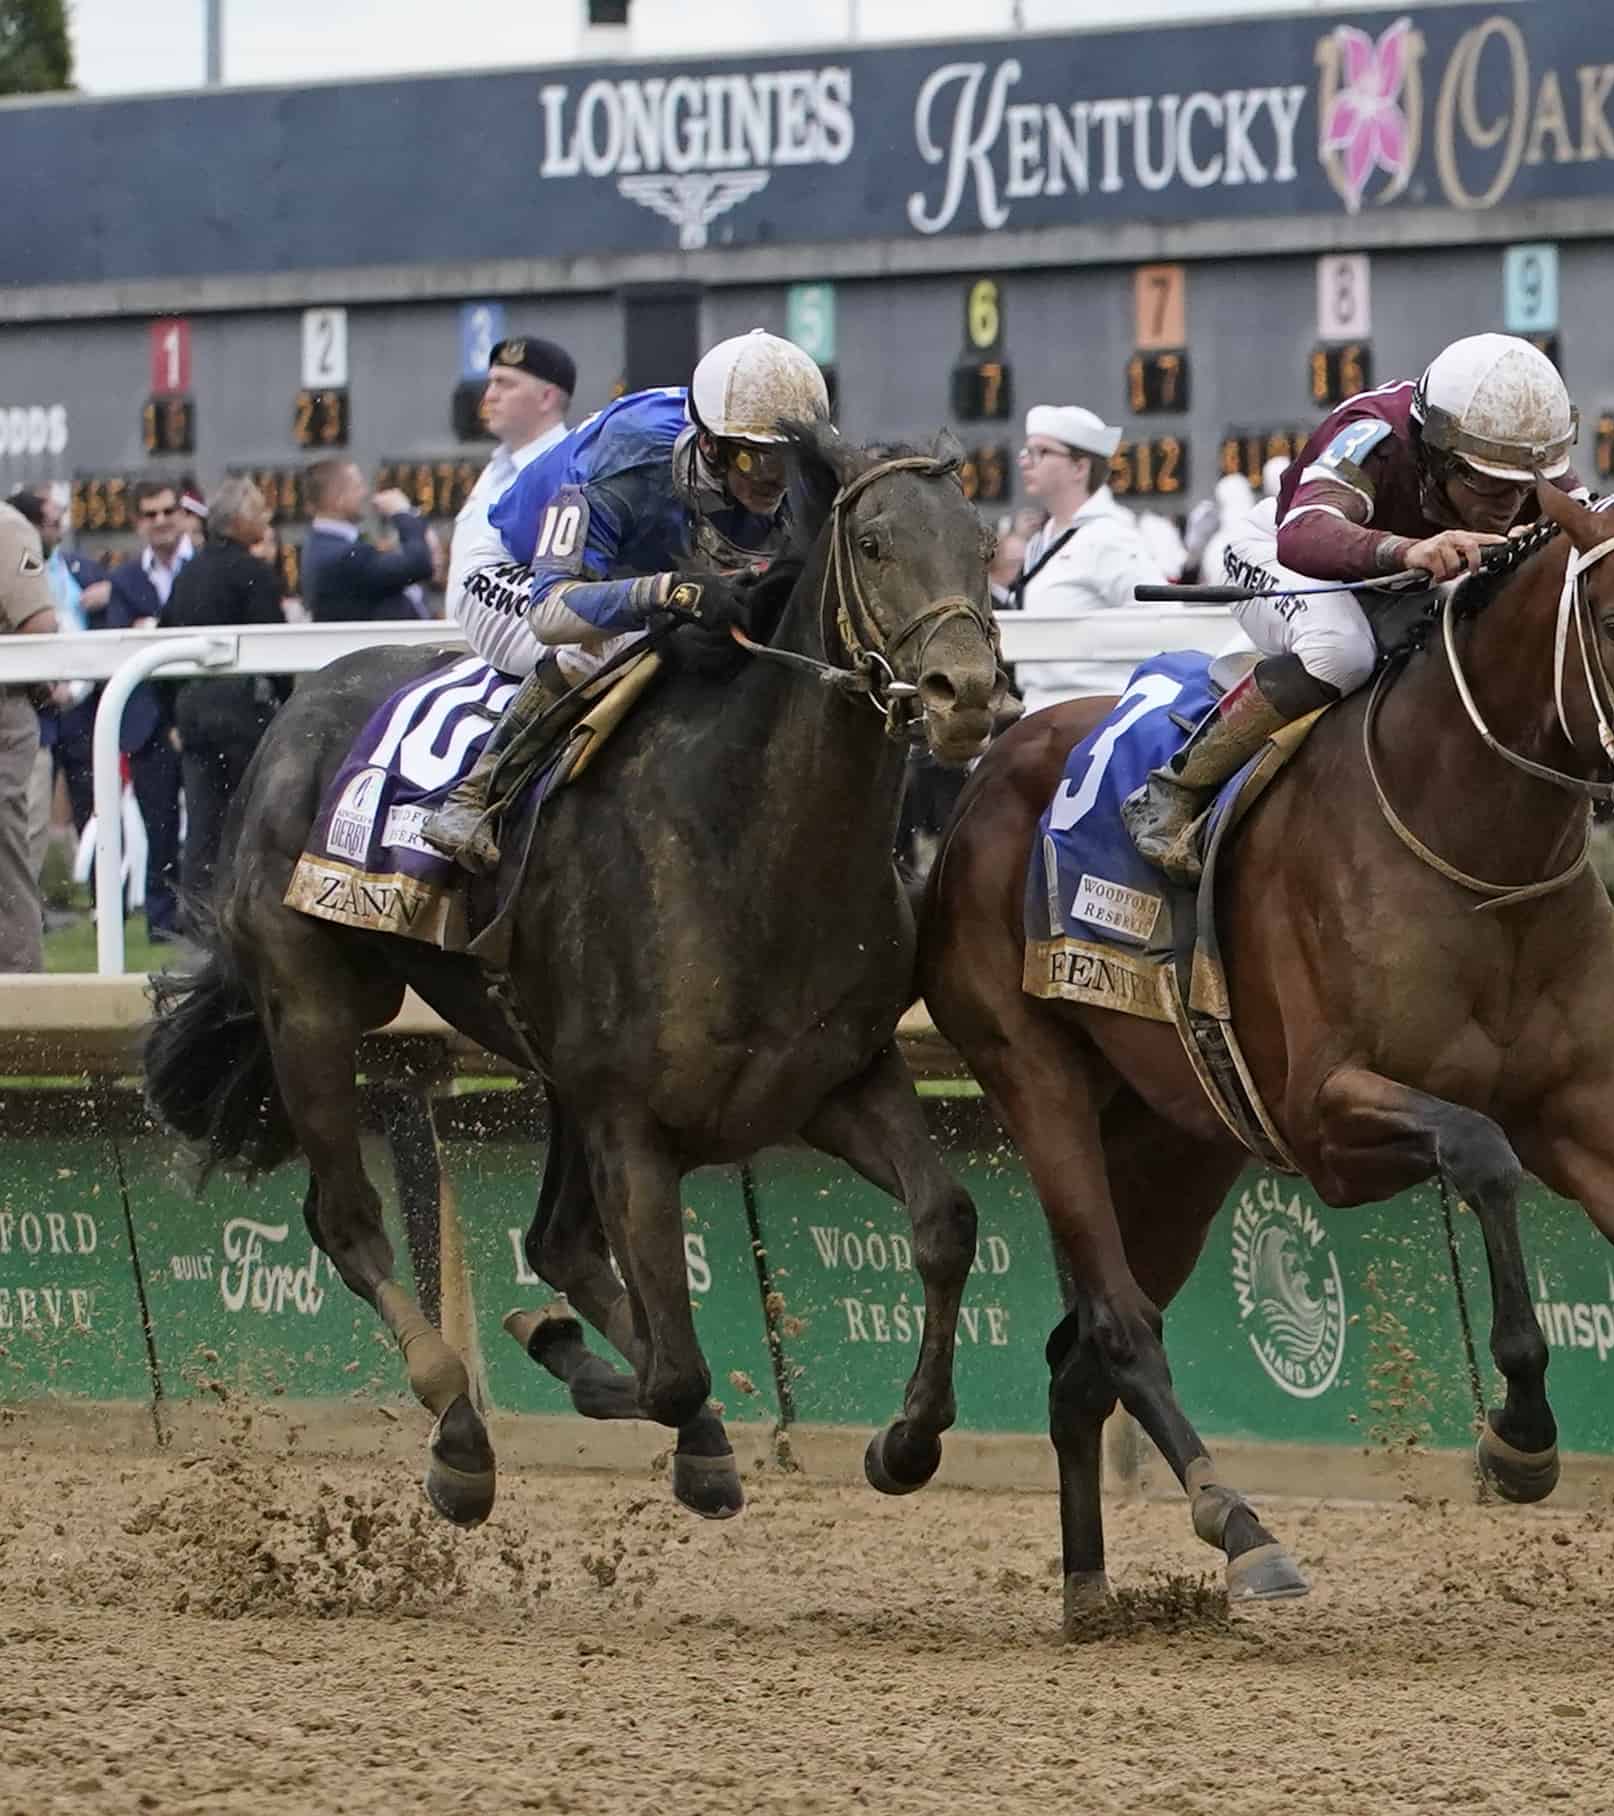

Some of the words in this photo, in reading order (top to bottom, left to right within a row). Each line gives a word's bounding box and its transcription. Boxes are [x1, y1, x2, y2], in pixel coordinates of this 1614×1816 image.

[540, 68, 854, 178] LONGINES
[907, 58, 1306, 234] KENTUCKY
[968, 279, 999, 348] 6
[1150, 278, 1170, 337] 7
[1335, 258, 1355, 325] 8
[1522, 253, 1546, 317] 9
[163, 325, 180, 389] 1
[319, 317, 334, 375] 2
[1326, 421, 1381, 467] 3
[535, 505, 581, 558] 10
[367, 656, 522, 792] 10
[1048, 673, 1184, 831] 3
[0, 1212, 97, 1254] FORD
[809, 1227, 1011, 1275] WOODD
[1231, 1189, 1261, 1320] WHITE
[1257, 1178, 1327, 1247] CLAW
[171, 1255, 212, 1280] BUILT
[220, 1217, 325, 1315] Ford
[844, 1297, 1010, 1346] RESVE
[1262, 1338, 1307, 1385] HARD
[1308, 1277, 1340, 1382] SELTZER
